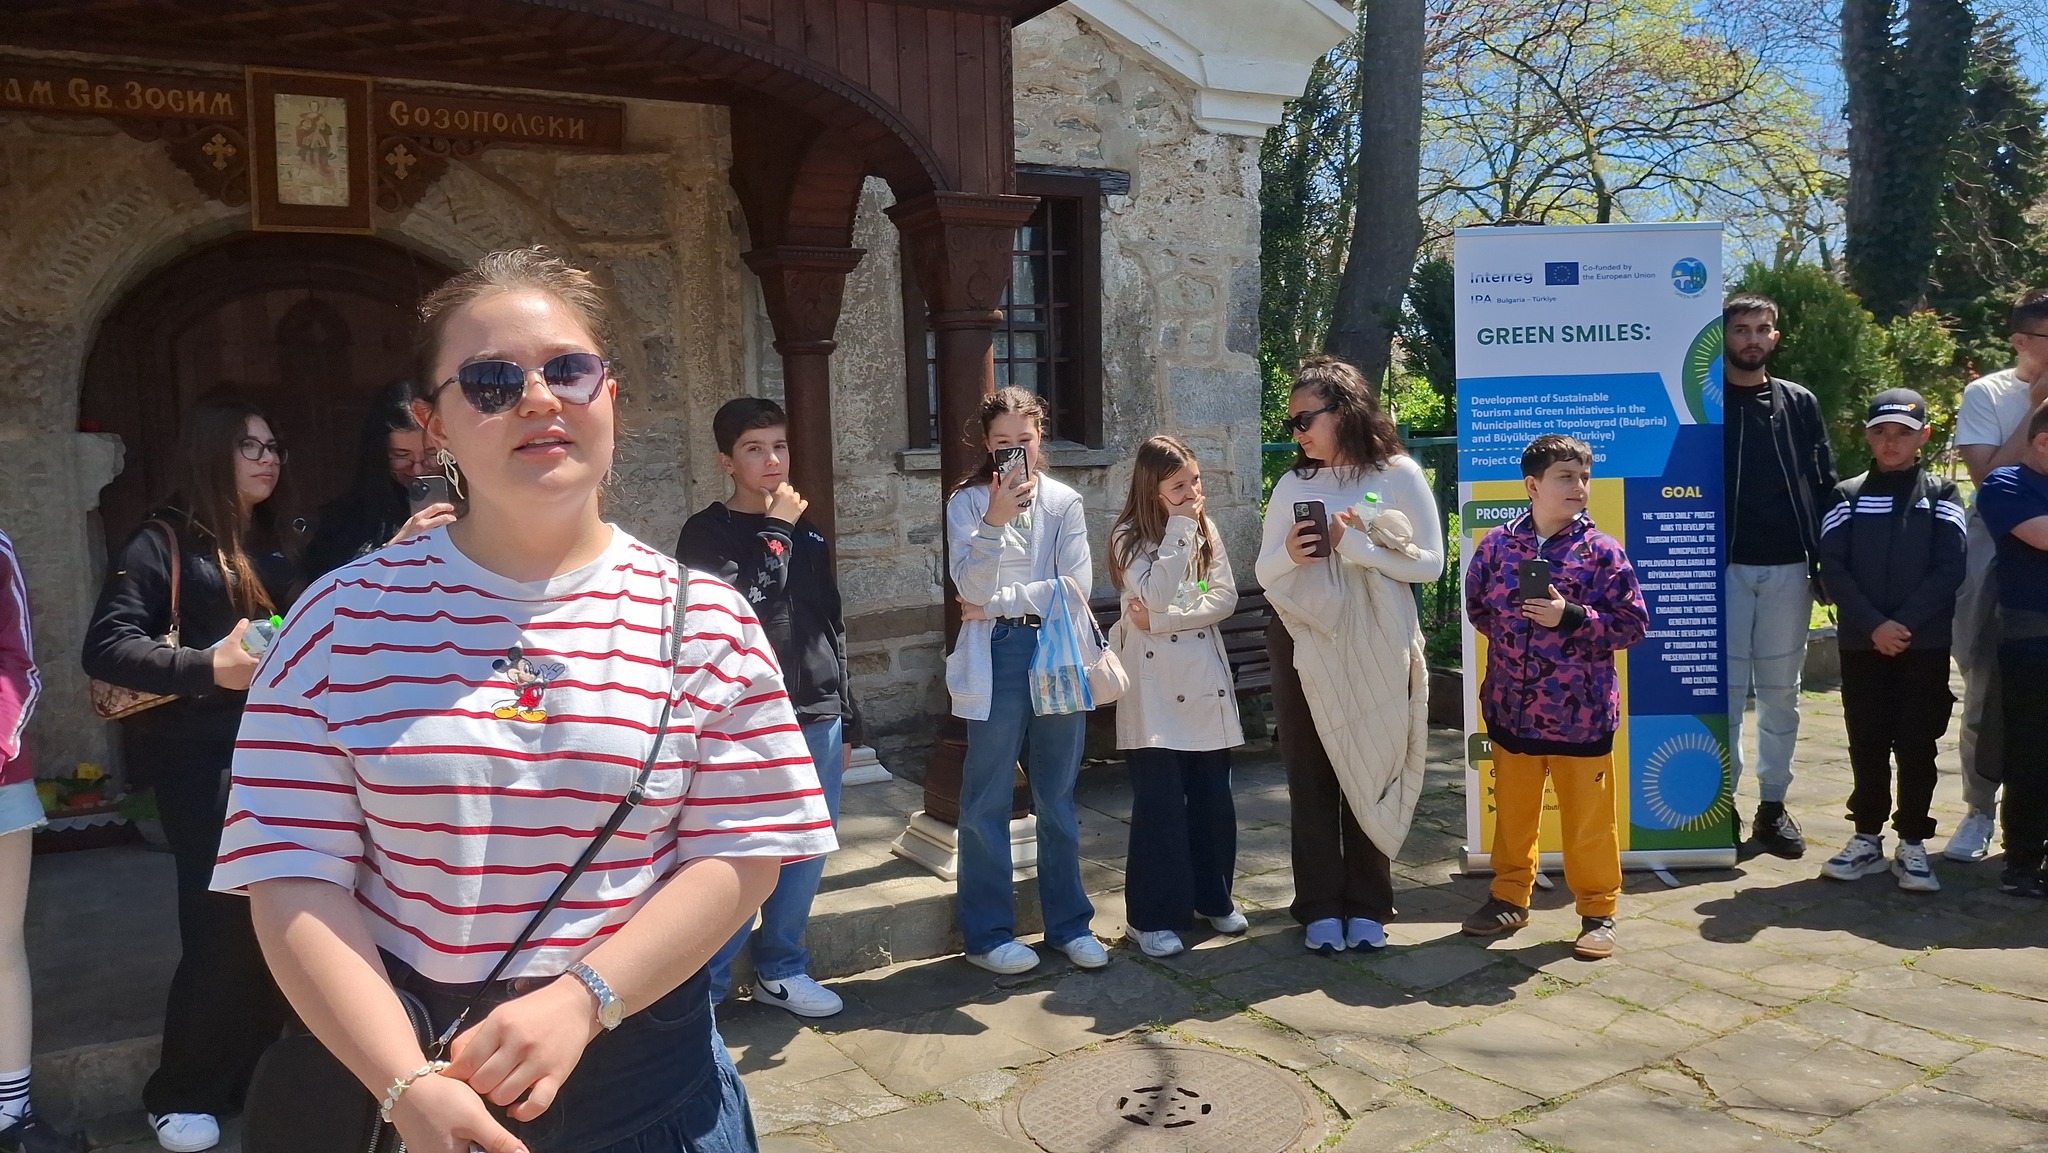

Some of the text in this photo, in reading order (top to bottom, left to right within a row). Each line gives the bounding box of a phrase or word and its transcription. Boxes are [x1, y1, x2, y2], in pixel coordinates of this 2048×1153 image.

[1470, 272, 1533, 284] Interreg
[1470, 295, 1492, 304] IPA
[1477, 323, 1651, 346] GREEN SMILES:
[1471, 392, 1609, 405] Development of Sustainable
[1471, 404, 1646, 418] Tourism and Green Initiatives in the
[1471, 419, 1542, 431] Municipalities
[1556, 417, 1617, 429] Topolovgrad
[1619, 416, 1667, 428] (Bulgaria)
[1471, 433, 1491, 443] and
[1572, 430, 1615, 441] (Turkiye)
[1471, 456, 1507, 467] Project
[1661, 486, 1703, 498] GOAL
[1642, 512, 1653, 520] THE
[1694, 511, 1715, 519] PROJECT
[1683, 523, 1705, 531] DEVELOP
[1669, 547, 1708, 555] MUNICIPALITIES
[1676, 559, 1705, 567] (BULGARIA)
[1693, 570, 1716, 578] (TURKEY)
[1688, 582, 1716, 590] INITIATIVES
[1670, 594, 1688, 602] GREEN
[1656, 606, 1682, 614] ENGAGING
[1668, 618, 1700, 626] GENERATION
[1645, 629, 1717, 638] SUSTAINABLE DEVELOPMENT
[1662, 653, 1700, 661] PRESERVATION
